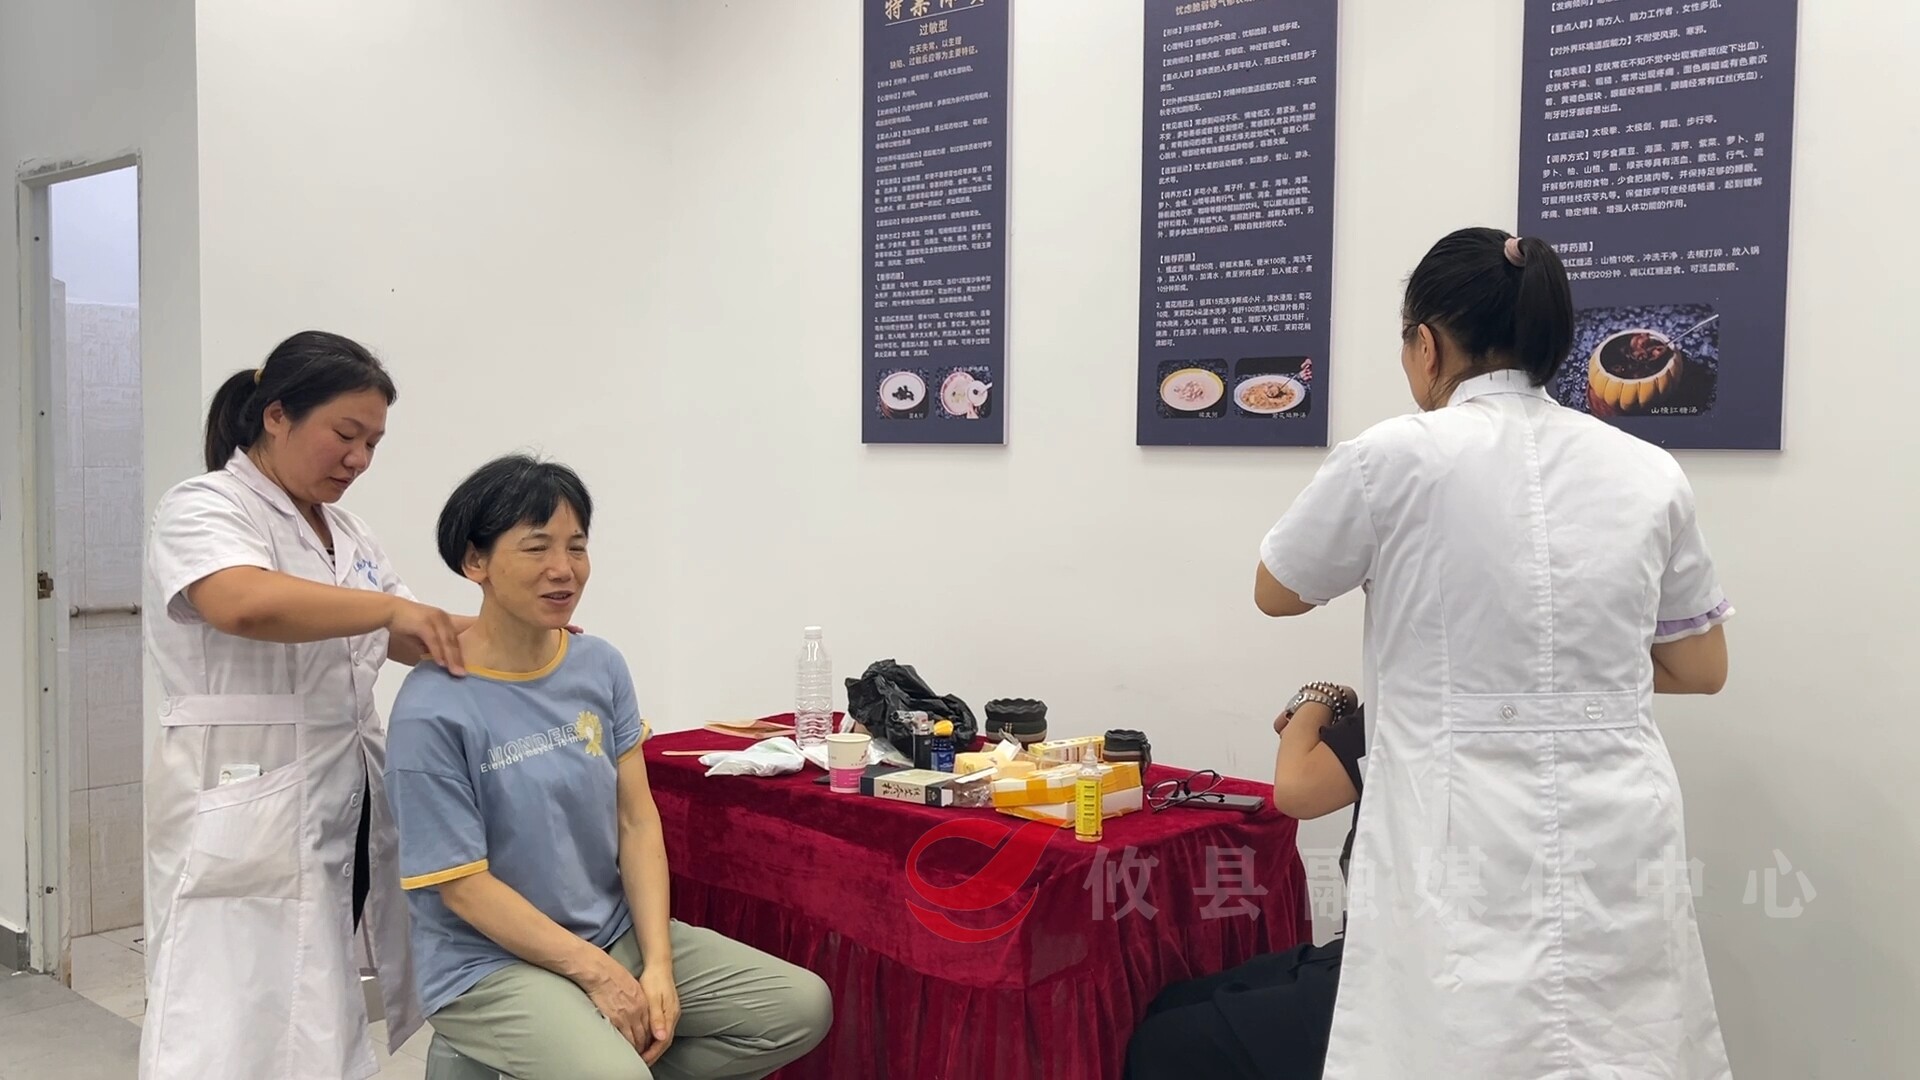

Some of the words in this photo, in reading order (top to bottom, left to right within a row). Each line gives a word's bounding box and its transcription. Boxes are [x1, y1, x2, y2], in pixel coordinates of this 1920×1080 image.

[1552, 0, 1618, 12] 【发病倾向】
[1551, 1, 1722, 34] 【重点人群】南方人、脑力工作者，女性多见。
[919, 19, 948, 36] 过敏型
[1550, 25, 1707, 57] 【对外界环境适应能力】不耐受风邪、寒邪。
[1545, 104, 1622, 120] 刷牙时牙龈容易出血。
[1548, 115, 1717, 142] 【适宜运动】太极拳、太极剑、舞蹈、步行等。
[1160, 253, 1196, 264] 【推荐药膳】
[480, 753, 524, 773] Everyday
